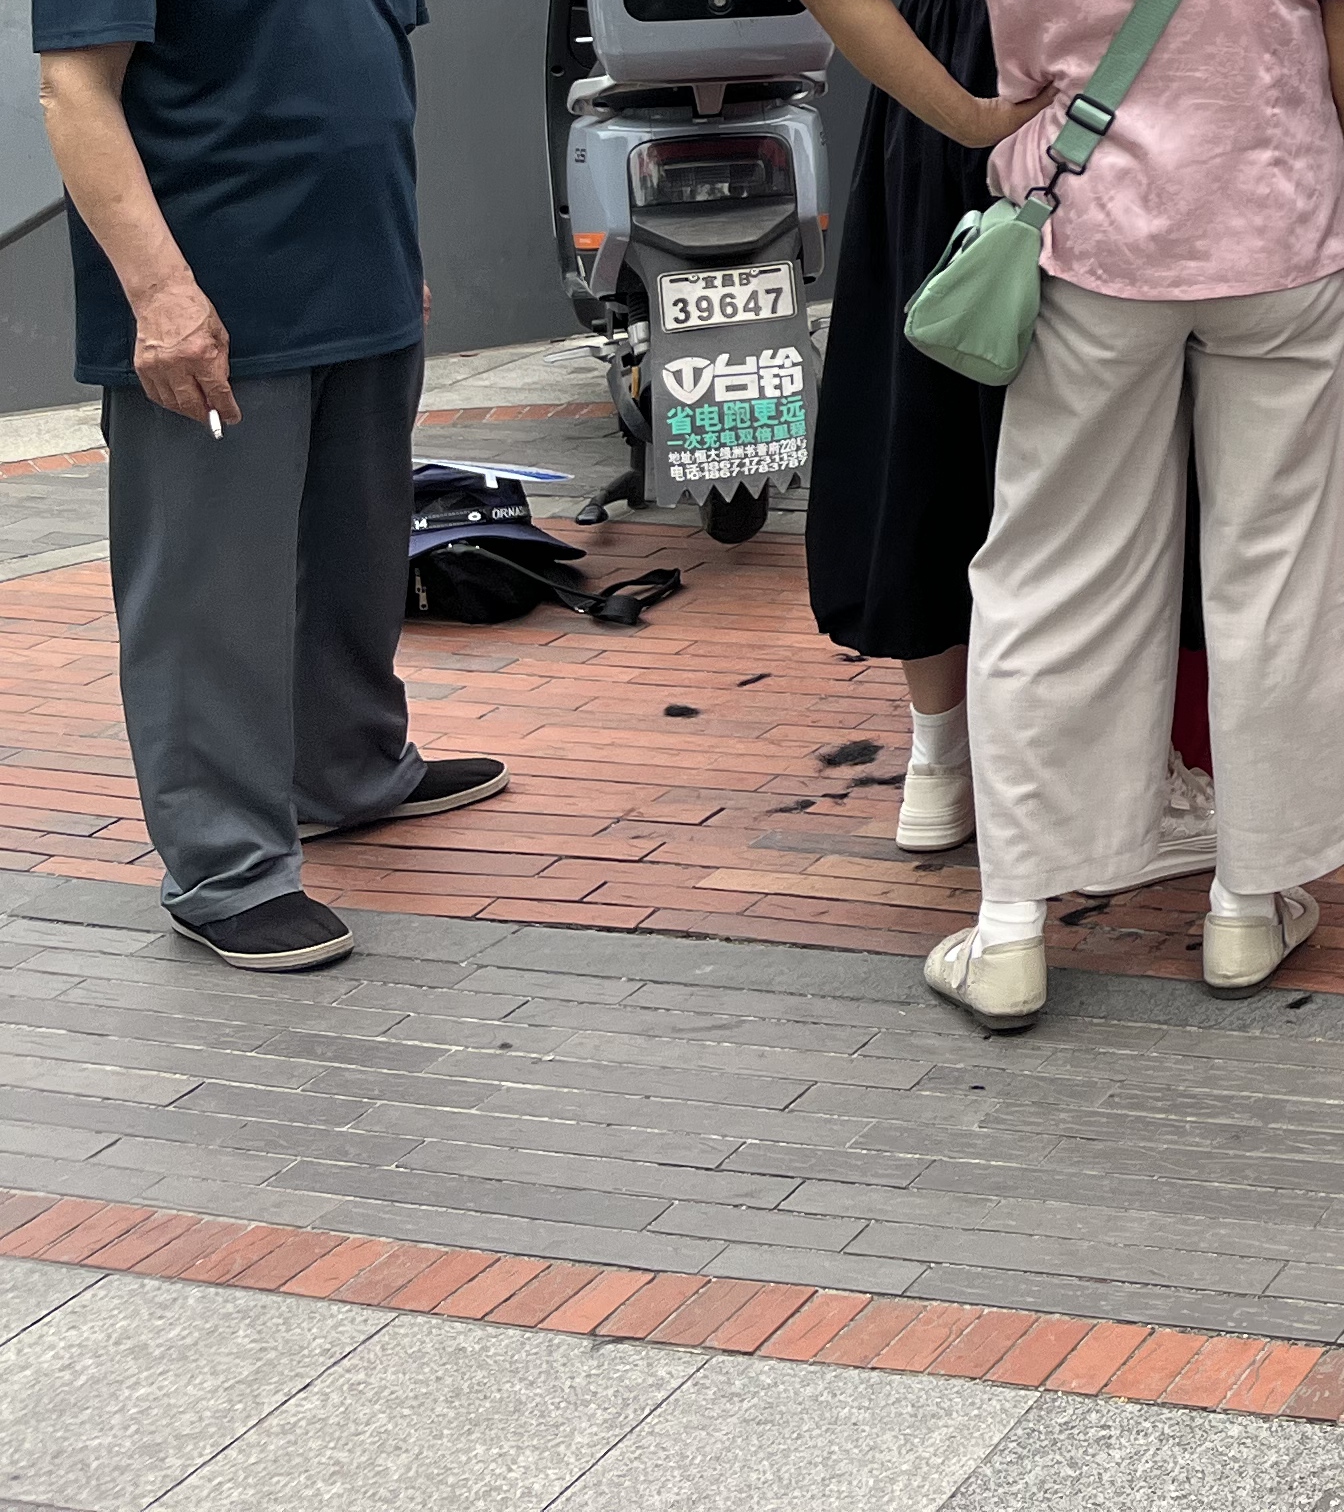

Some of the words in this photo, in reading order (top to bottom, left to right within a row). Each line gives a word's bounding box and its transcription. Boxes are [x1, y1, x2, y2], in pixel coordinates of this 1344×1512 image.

[702, 272, 752, 289] 宜昌B
[672, 287, 783, 324] 39647
[714, 346, 804, 402] 台铃
[666, 395, 806, 435] 省电跑更远
[667, 421, 807, 450] 一次充电双倍里程
